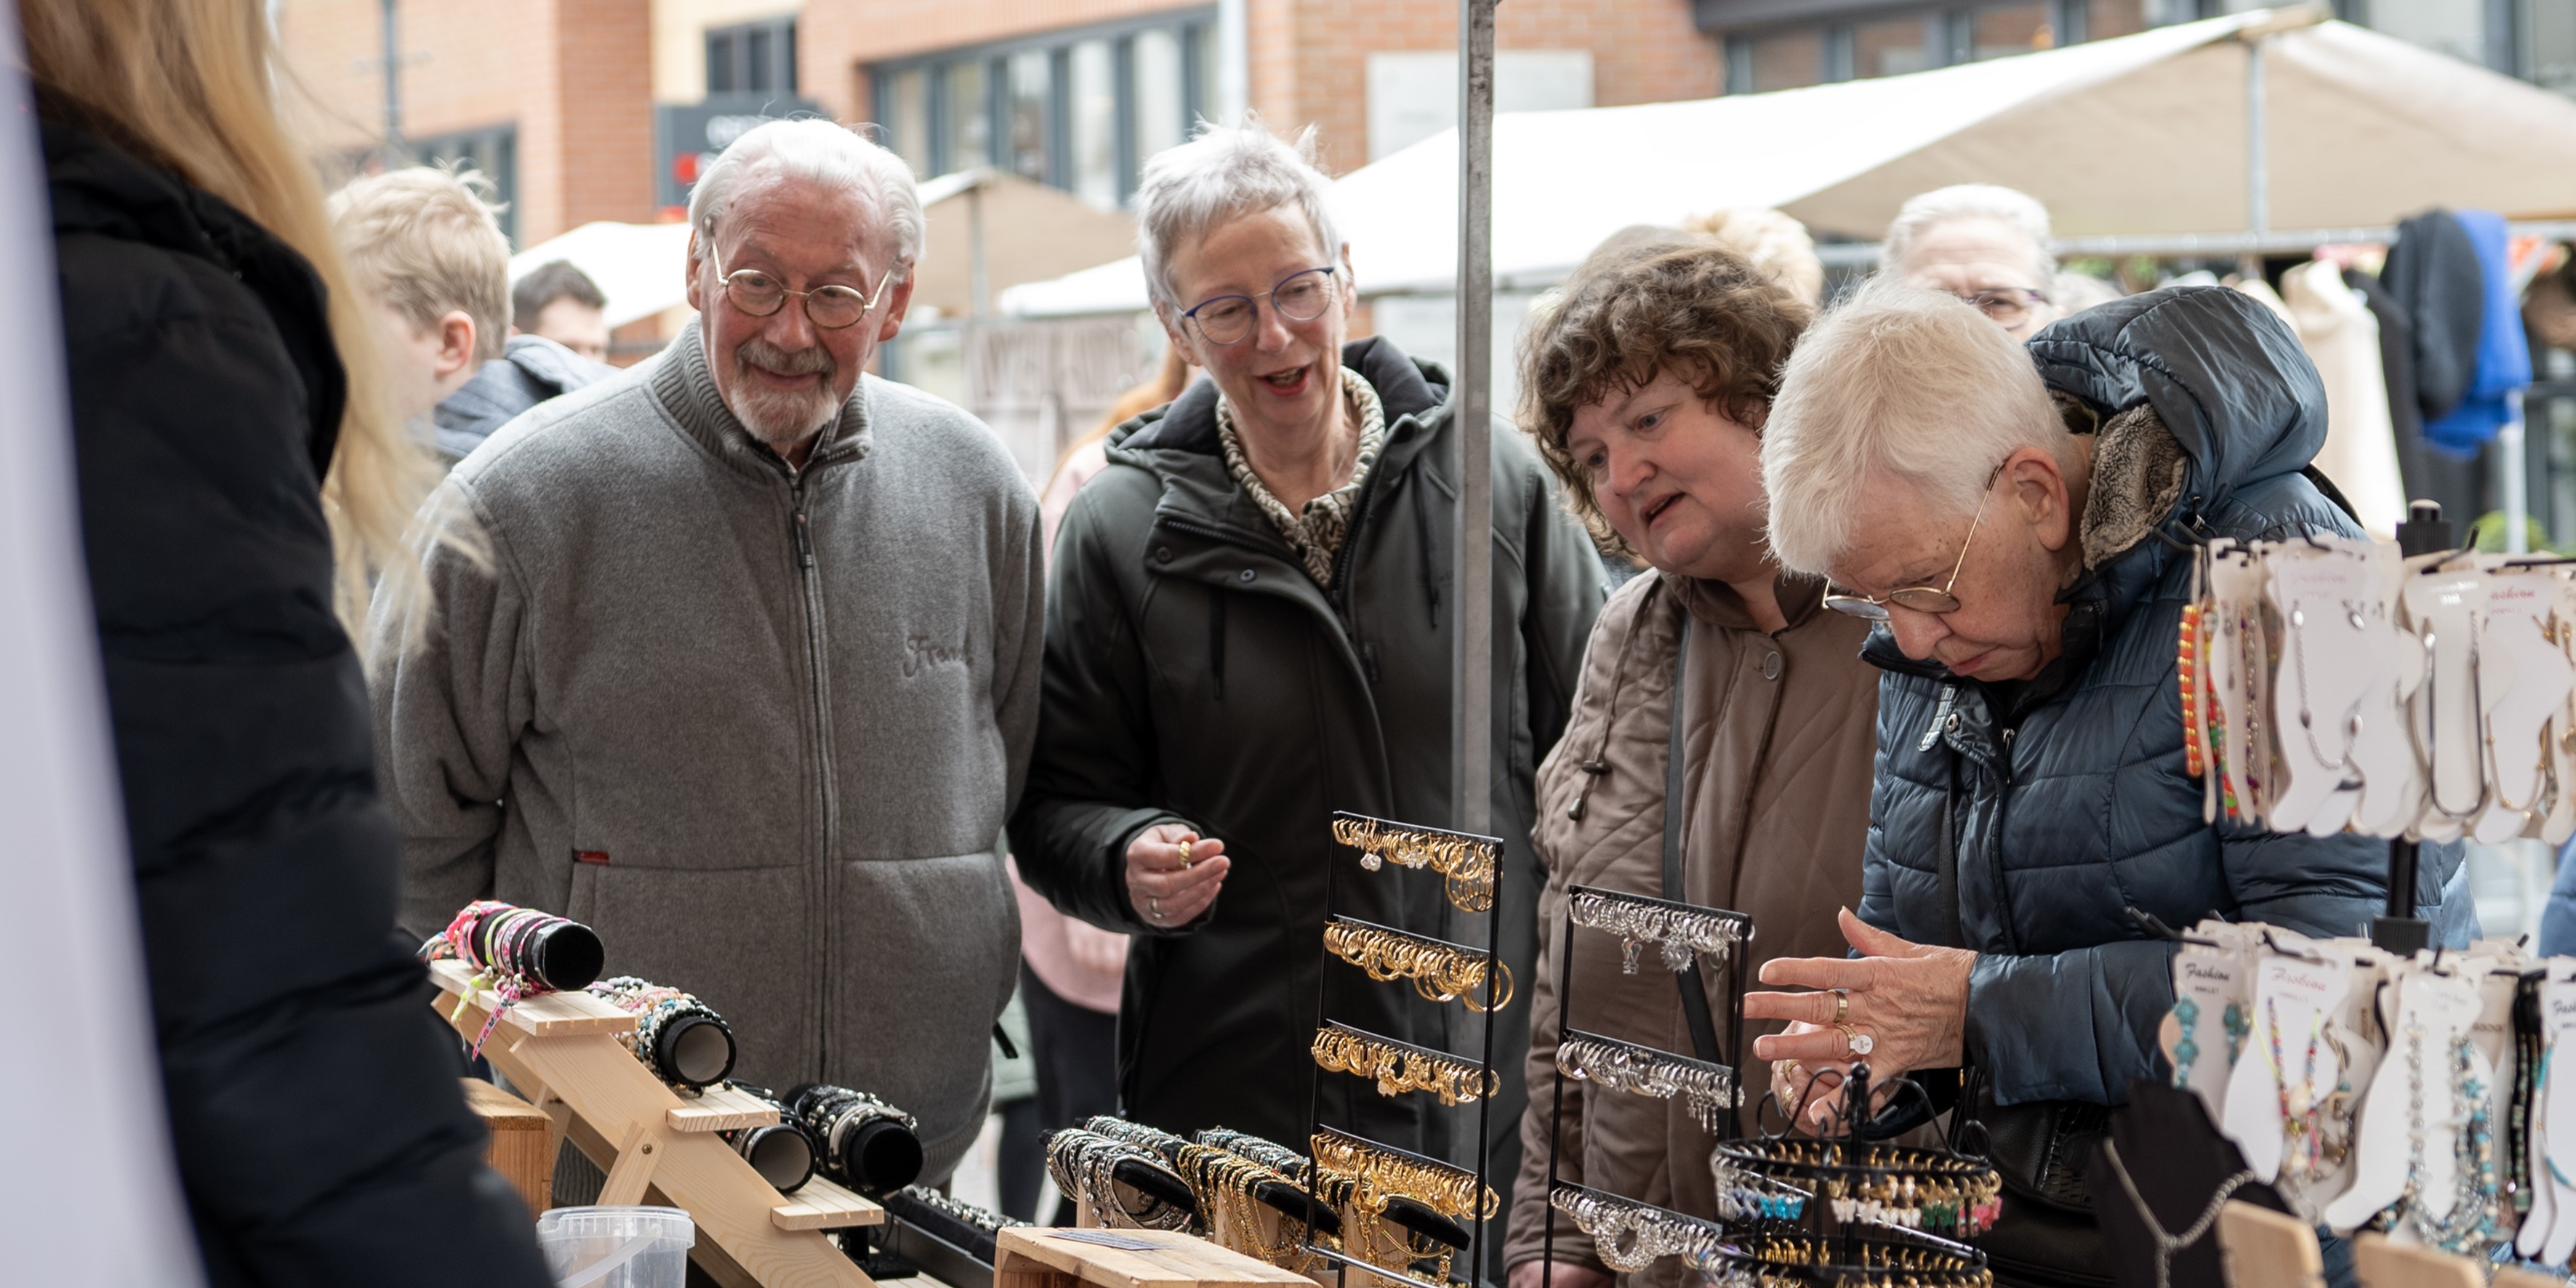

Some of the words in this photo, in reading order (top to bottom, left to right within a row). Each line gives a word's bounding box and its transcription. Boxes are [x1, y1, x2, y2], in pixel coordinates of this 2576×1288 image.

[2489, 585, 2535, 600] ashion
[2186, 962, 2231, 982] Fashion
[2271, 966, 2327, 992] Fashion
